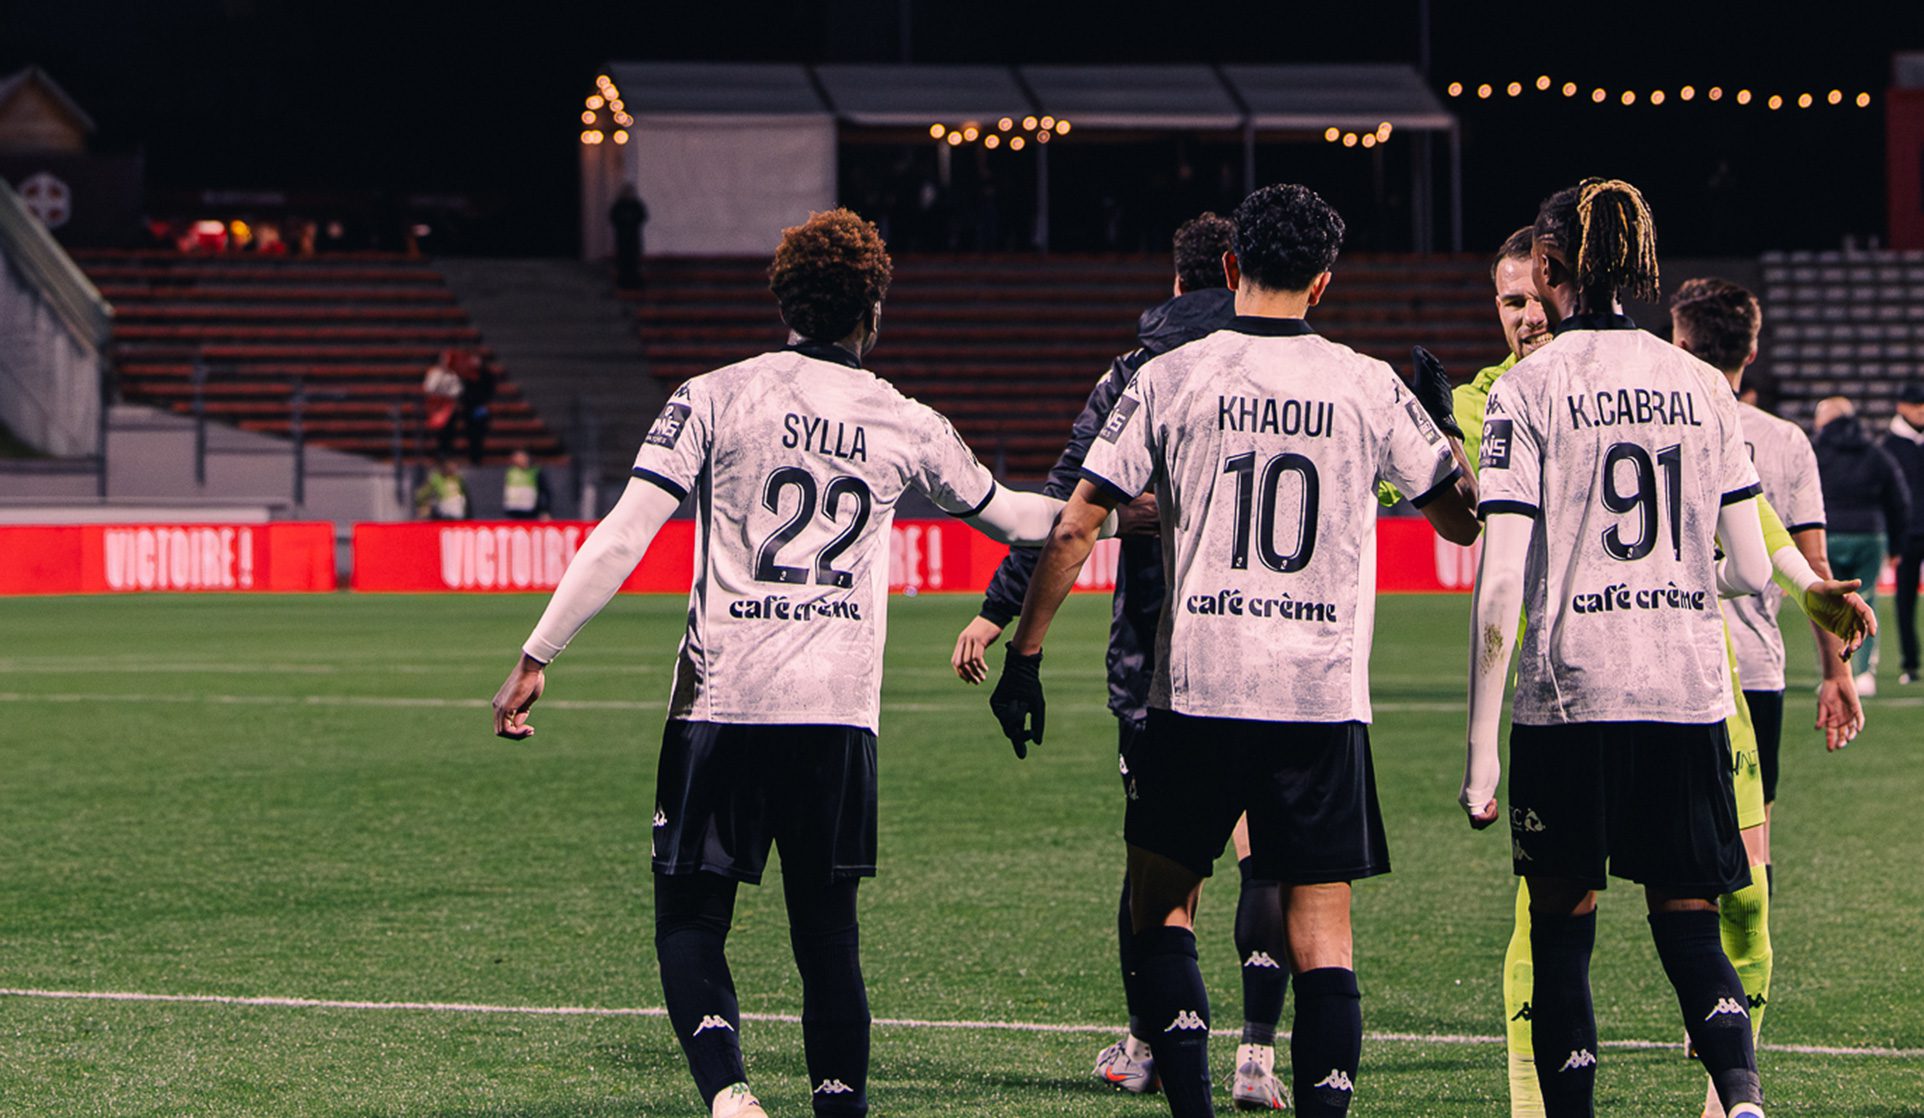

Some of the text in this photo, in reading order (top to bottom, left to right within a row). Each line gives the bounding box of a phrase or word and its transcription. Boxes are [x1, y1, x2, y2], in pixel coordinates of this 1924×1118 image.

[1218, 395, 1334, 438] KHAOUI
[1567, 388, 1702, 430] K.CABRAL
[782, 413, 867, 462] SYLLA
[1223, 450, 1320, 573] 10
[1601, 442, 1682, 562] 91
[754, 465, 872, 589] 22
[729, 595, 790, 620] café
[1186, 589, 1338, 623] café crème
[1572, 581, 1705, 614] café crème
